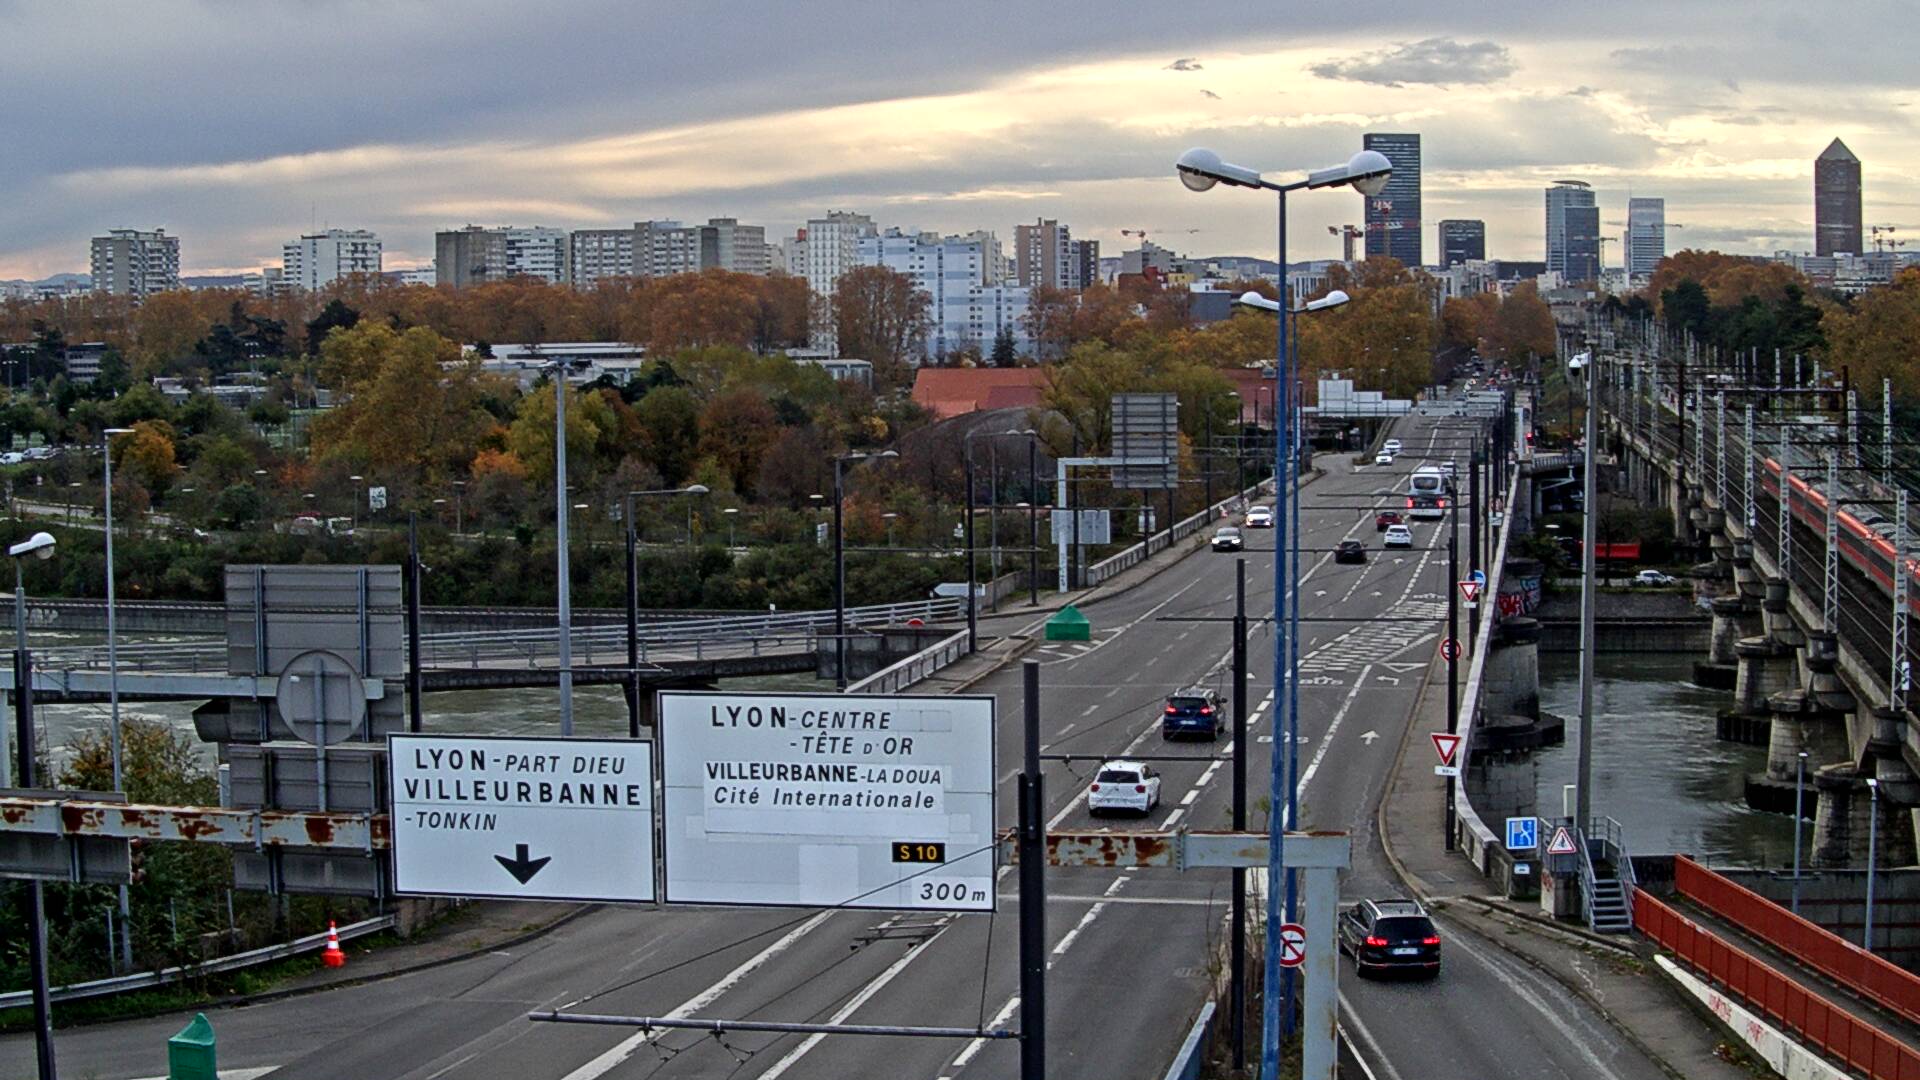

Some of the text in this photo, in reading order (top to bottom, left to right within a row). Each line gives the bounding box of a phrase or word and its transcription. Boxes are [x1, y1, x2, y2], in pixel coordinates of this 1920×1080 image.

[573, 756, 625, 774] DIEU
[892, 769, 941, 784] DOUA
[404, 778, 641, 806] VILLEURBANNE
[714, 786, 934, 808] Cité Internationale
[405, 811, 497, 830] -TONKIN
[920, 883, 986, 901] 300 m
